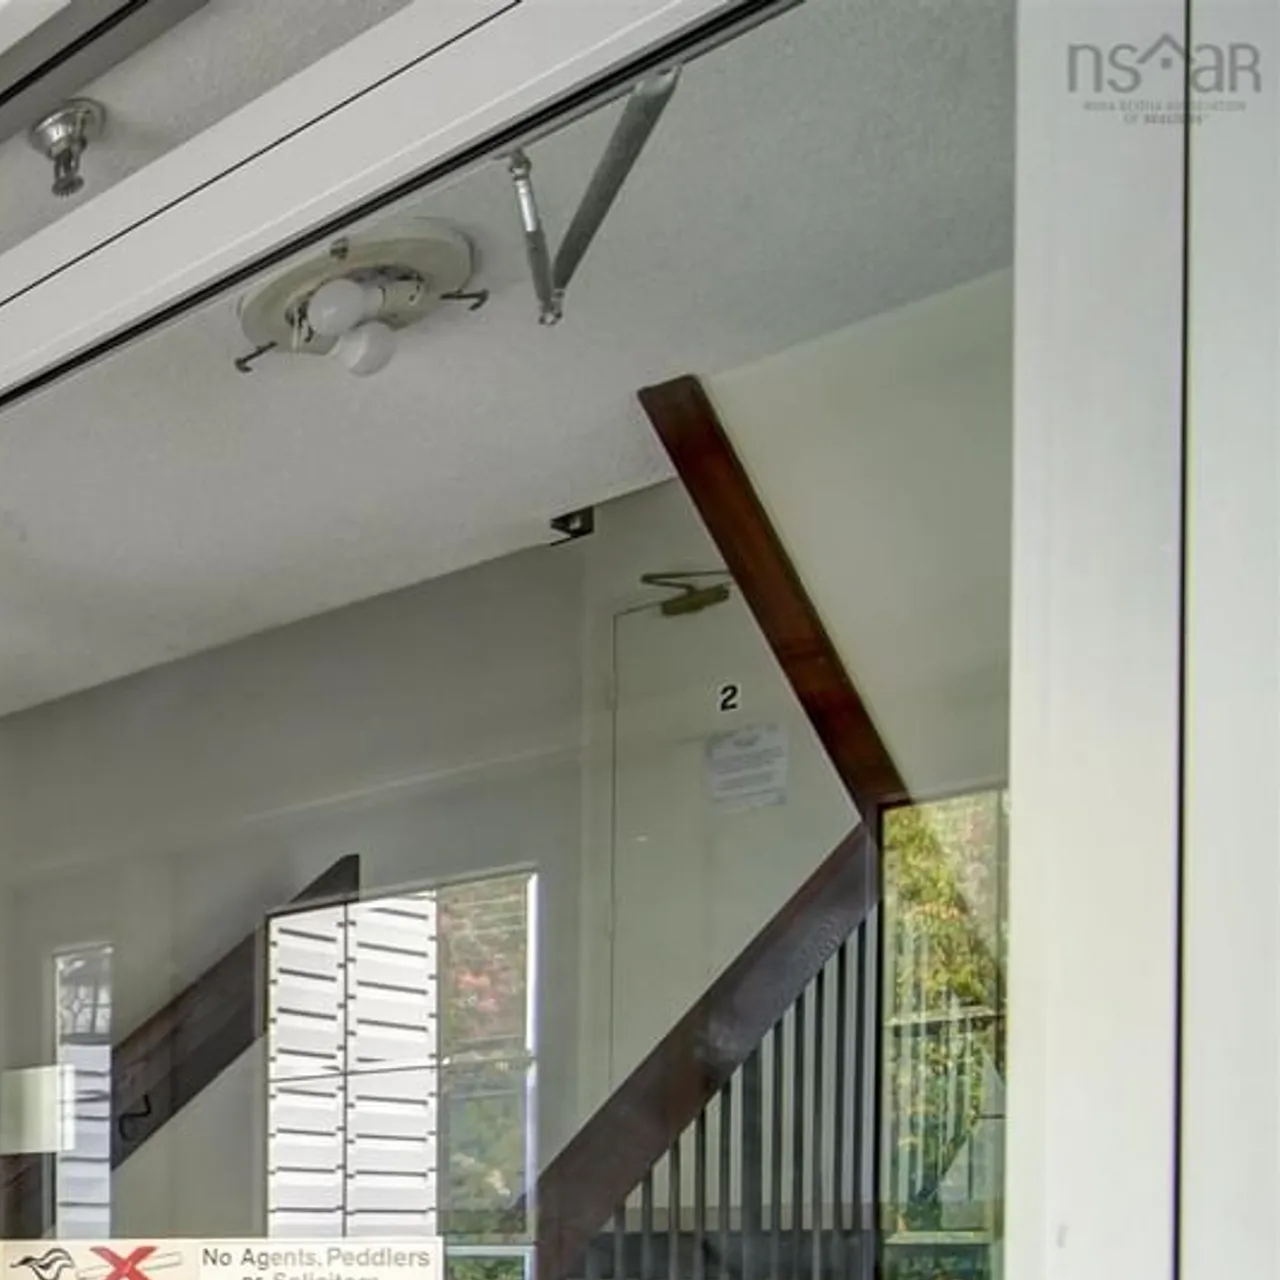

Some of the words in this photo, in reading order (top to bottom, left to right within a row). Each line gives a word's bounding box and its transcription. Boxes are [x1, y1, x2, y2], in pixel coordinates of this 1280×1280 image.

[719, 684, 739, 711] 2
[202, 1248, 232, 1267] No
[326, 1247, 431, 1267] Peddlers
